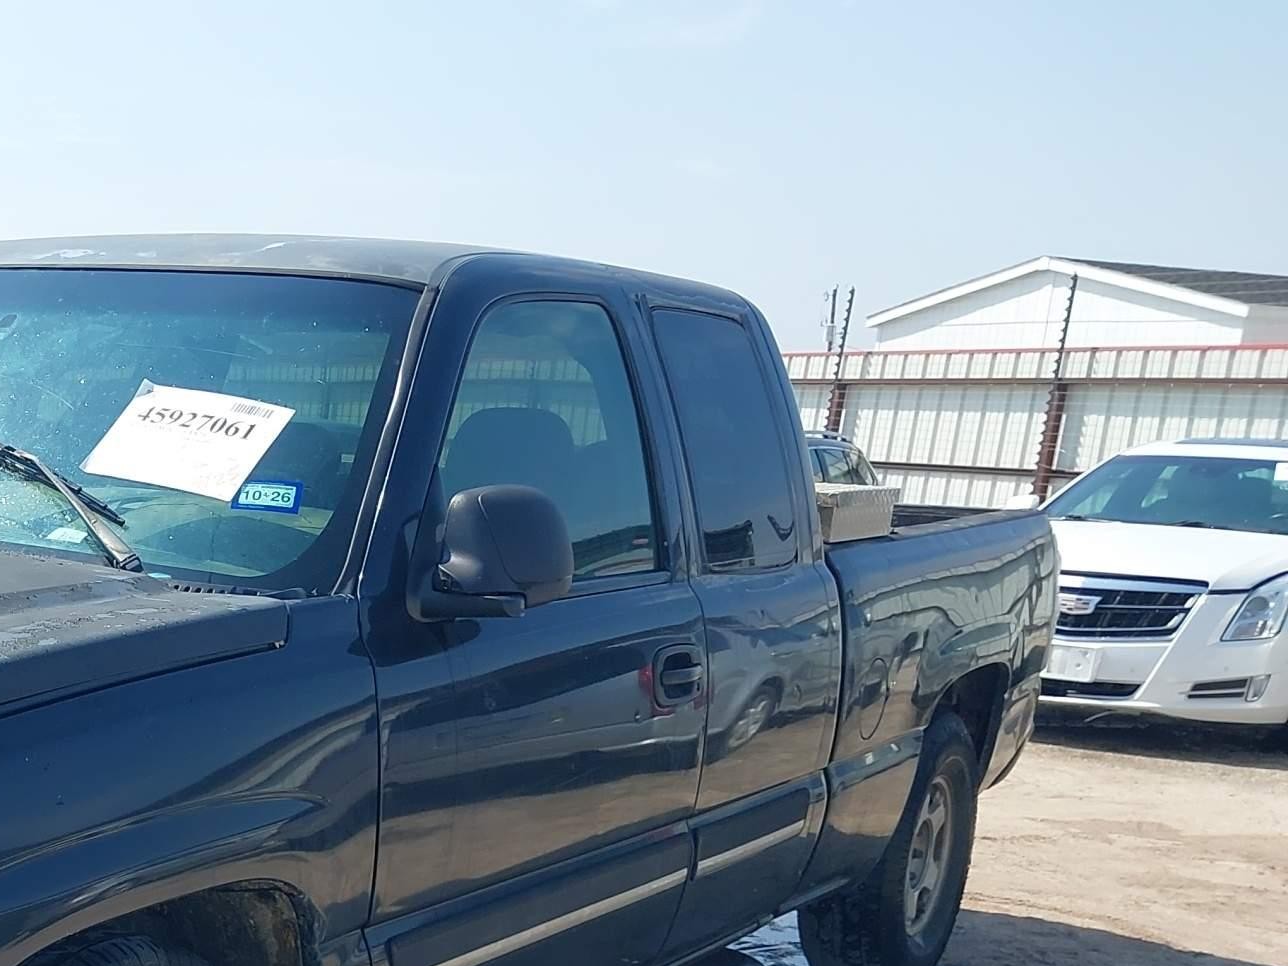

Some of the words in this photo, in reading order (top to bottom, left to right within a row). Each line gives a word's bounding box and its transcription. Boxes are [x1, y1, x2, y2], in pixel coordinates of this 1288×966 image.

[137, 405, 257, 441] 45927061
[243, 490, 262, 501] 10
[270, 491, 292, 503] 26
